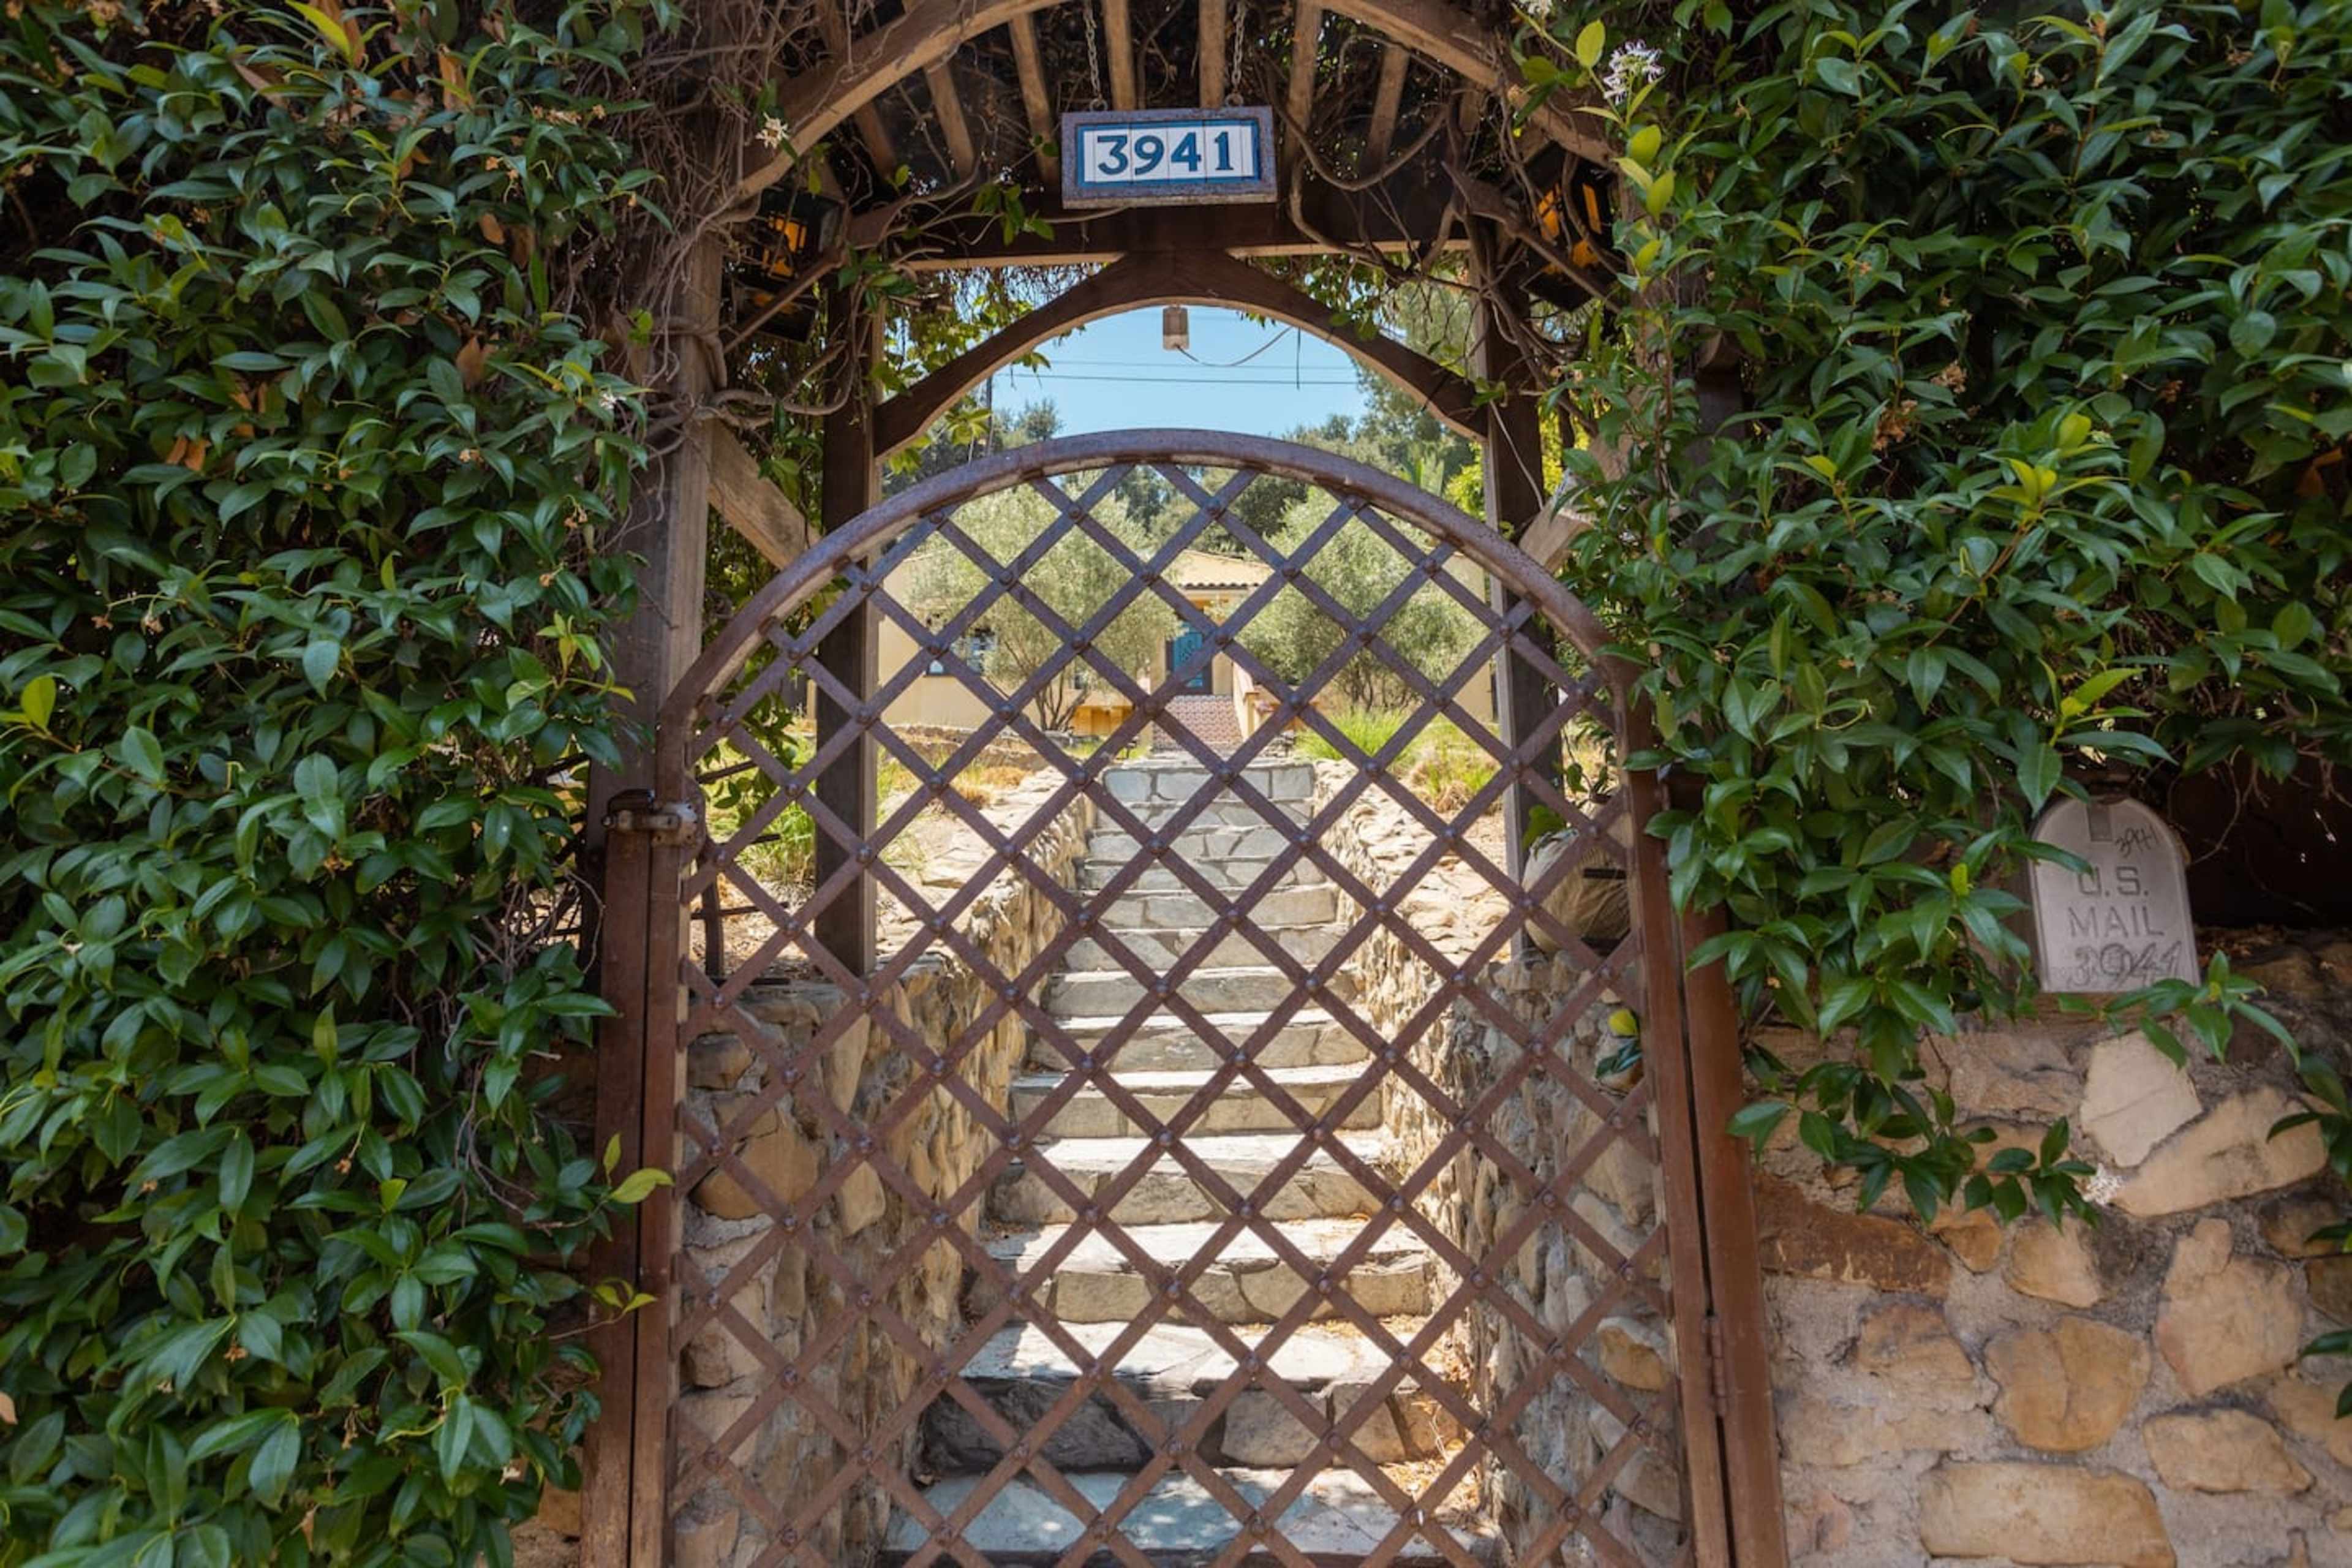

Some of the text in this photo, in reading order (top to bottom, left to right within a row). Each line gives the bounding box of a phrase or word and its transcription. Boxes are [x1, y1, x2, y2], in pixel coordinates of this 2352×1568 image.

[1097, 131, 1234, 175] 3941
[2078, 866, 2149, 895] U.S.
[2068, 905, 2164, 938] MAIL
